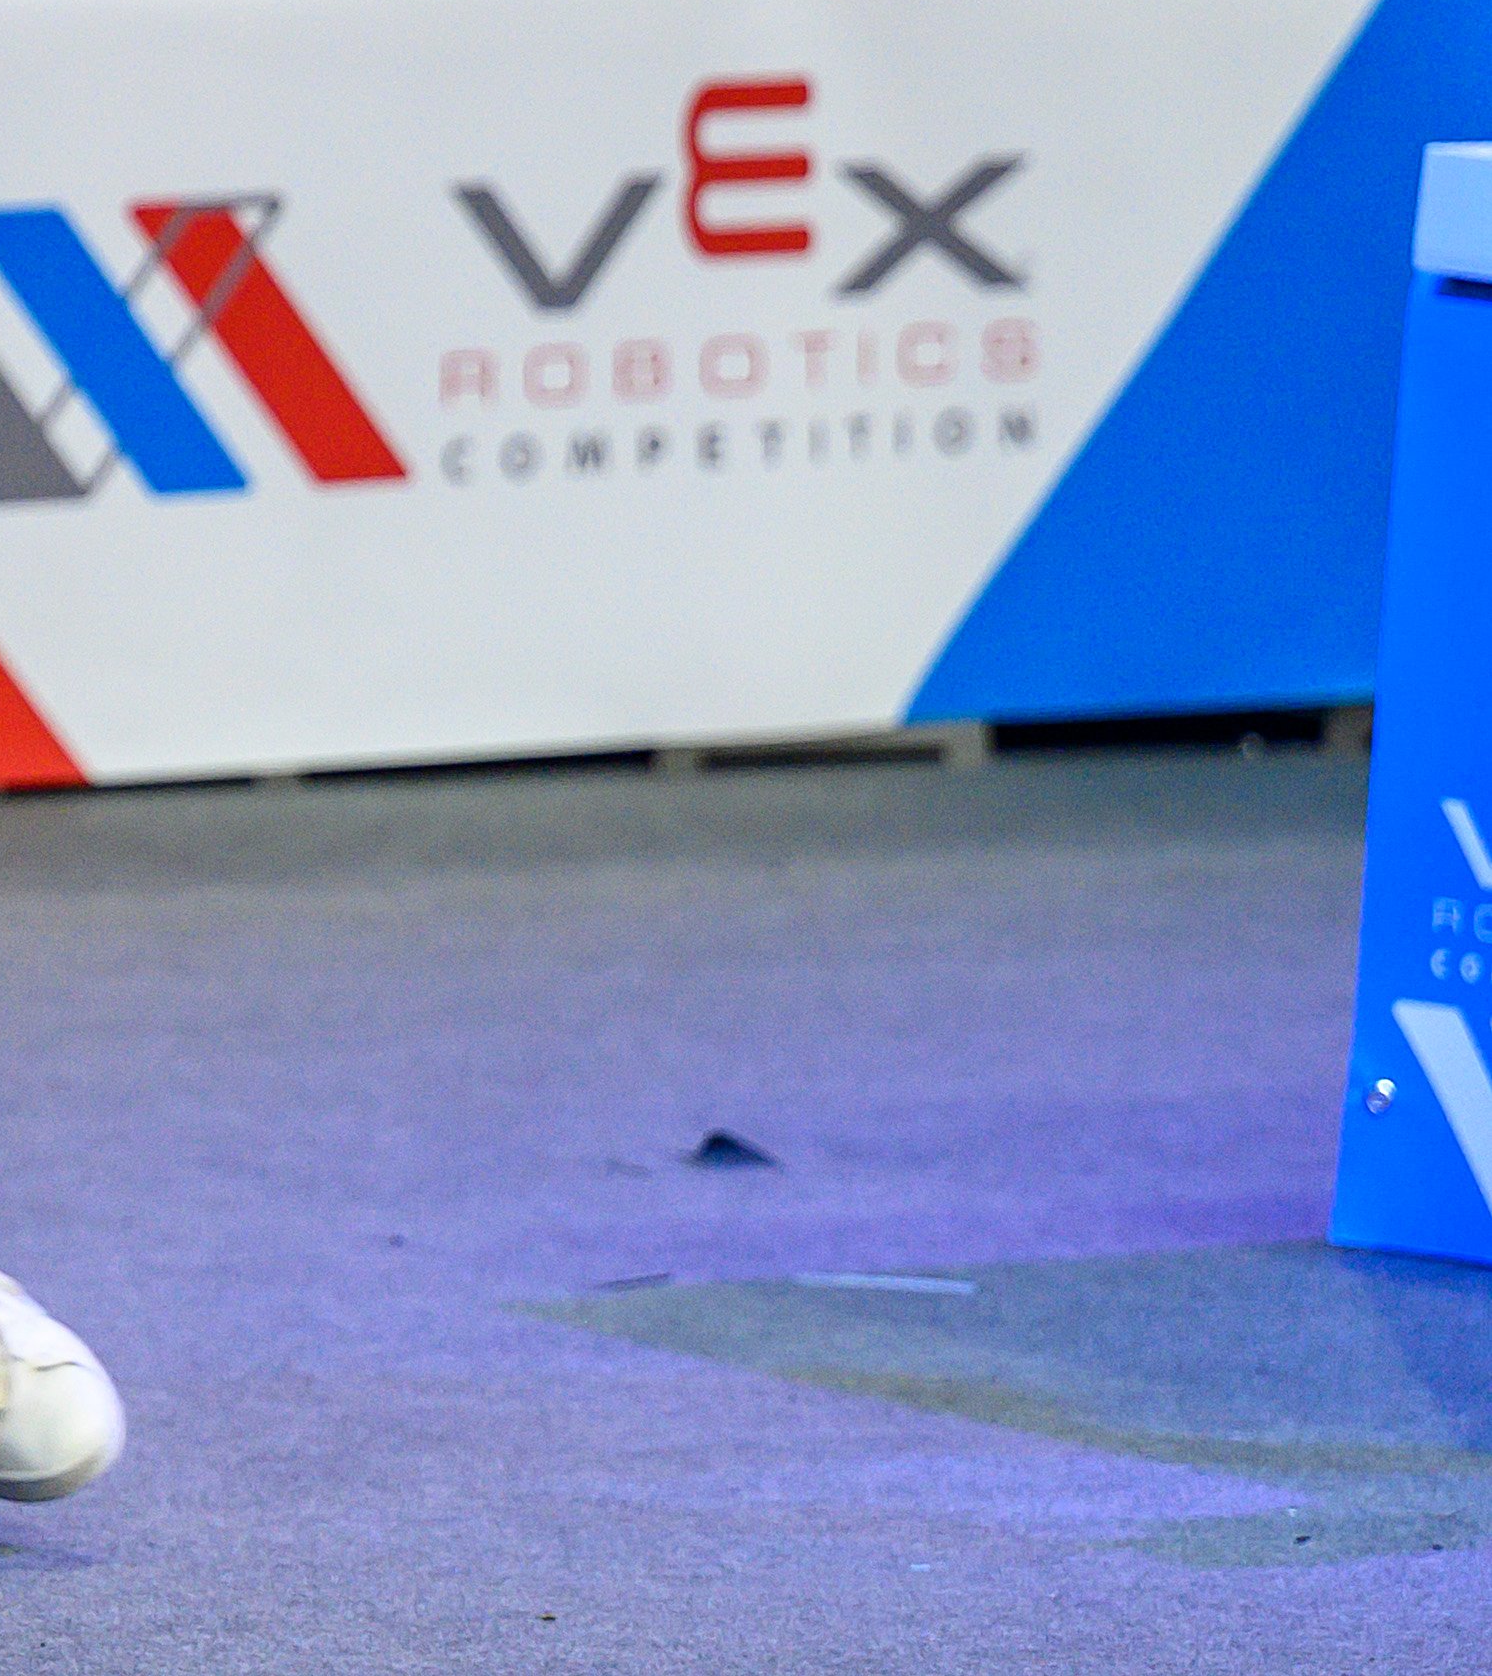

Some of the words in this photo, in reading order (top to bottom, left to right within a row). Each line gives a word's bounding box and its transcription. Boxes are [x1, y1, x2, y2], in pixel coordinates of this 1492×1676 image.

[454, 78, 1023, 310] VEX
[437, 318, 1040, 409] ROBOTICS
[439, 406, 1037, 485] COMPETITION
